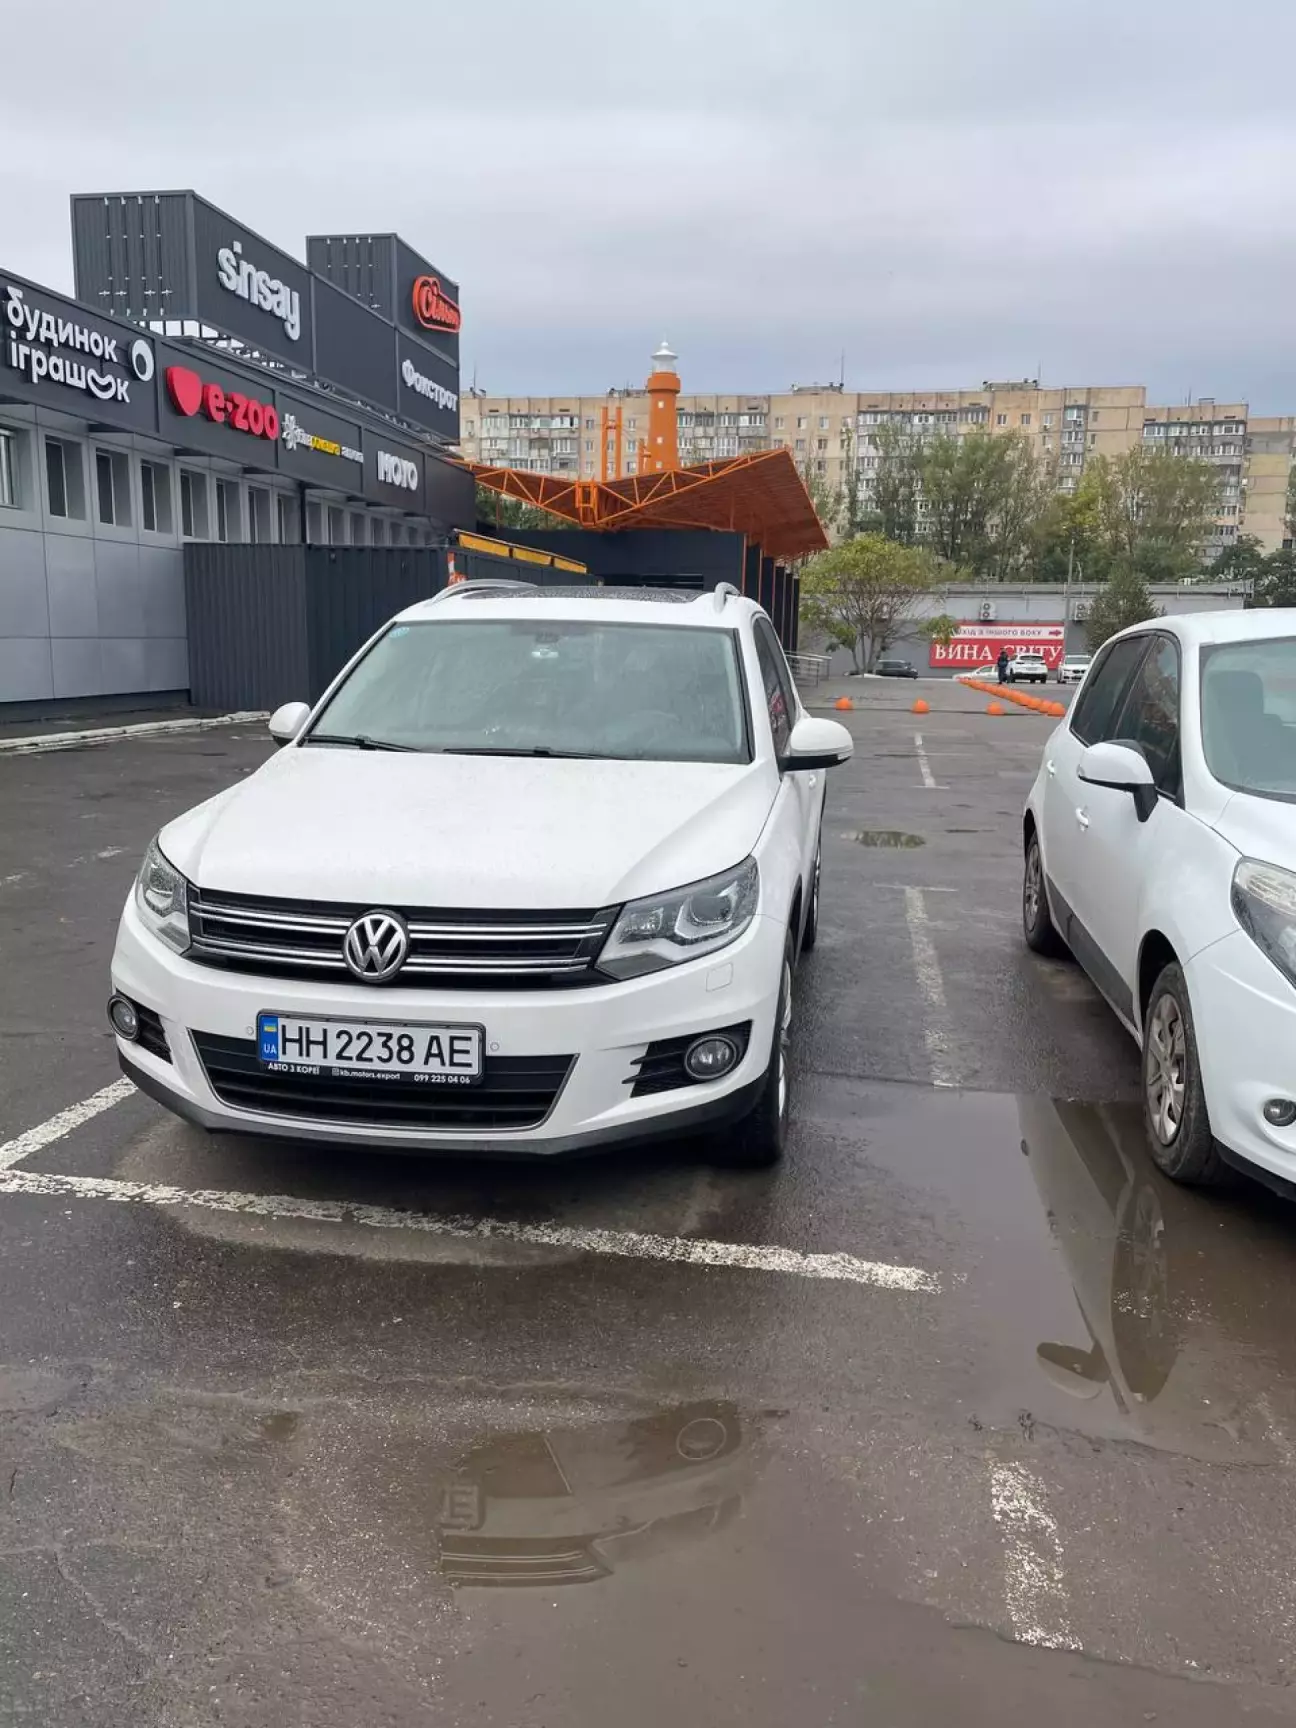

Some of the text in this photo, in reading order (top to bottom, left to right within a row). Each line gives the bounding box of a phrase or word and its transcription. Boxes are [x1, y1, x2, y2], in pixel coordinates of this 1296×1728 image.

[217, 241, 301, 341] sinsay
[7, 285, 118, 363] будинок
[10, 330, 131, 403] іграшок
[402, 358, 458, 412] Фокстрот
[935, 643, 994, 660] ВИНА
[264, 1043, 277, 1054] UA
[268, 1062, 288, 1072] АВТО
[280, 1024, 473, 1068] HH 2238 AE
